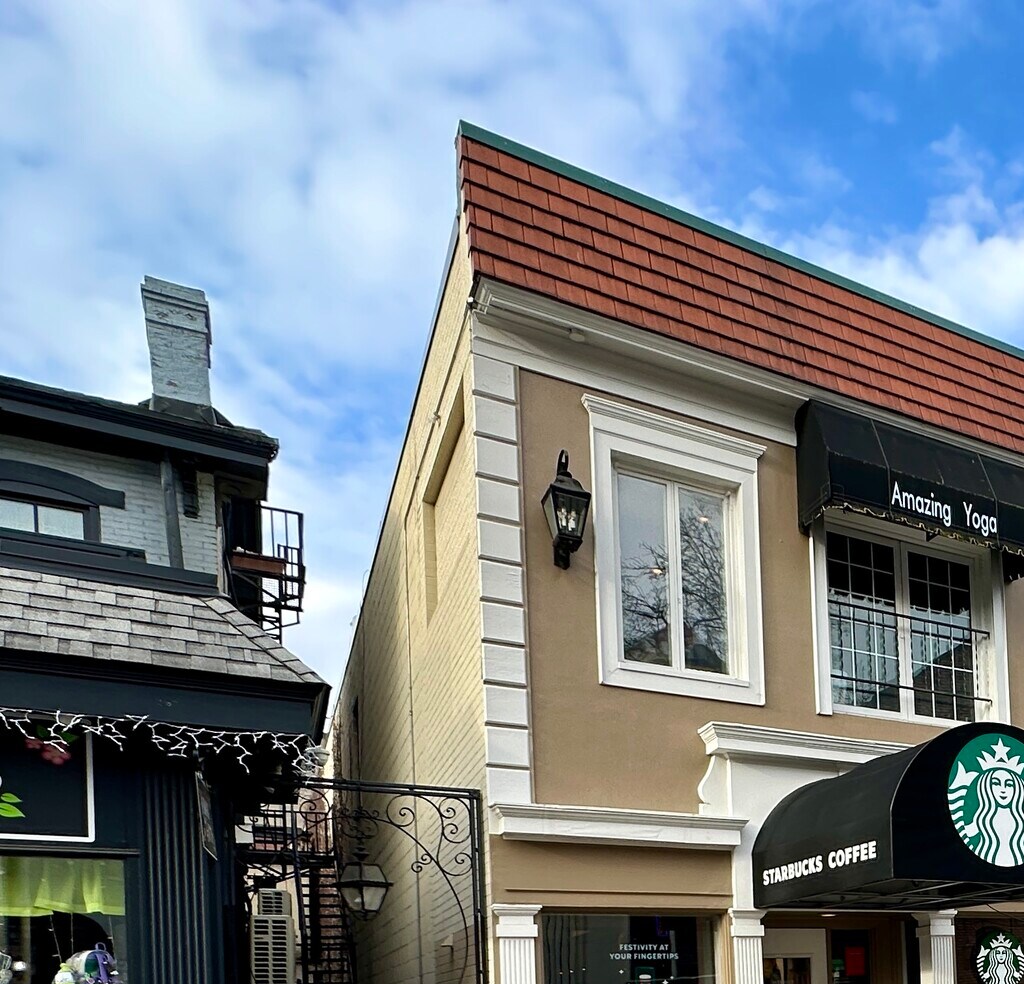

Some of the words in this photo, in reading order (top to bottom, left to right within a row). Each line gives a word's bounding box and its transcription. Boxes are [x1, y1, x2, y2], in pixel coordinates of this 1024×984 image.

[891, 481, 952, 527] Amazing
[963, 501, 998, 537] Yoga
[762, 855, 824, 886] STARBUCKS
[827, 840, 878, 869] COFFEE
[619, 943, 658, 951] FESTIVITY
[659, 943, 669, 951] AT
[633, 952, 679, 960] FINGERTIPS
